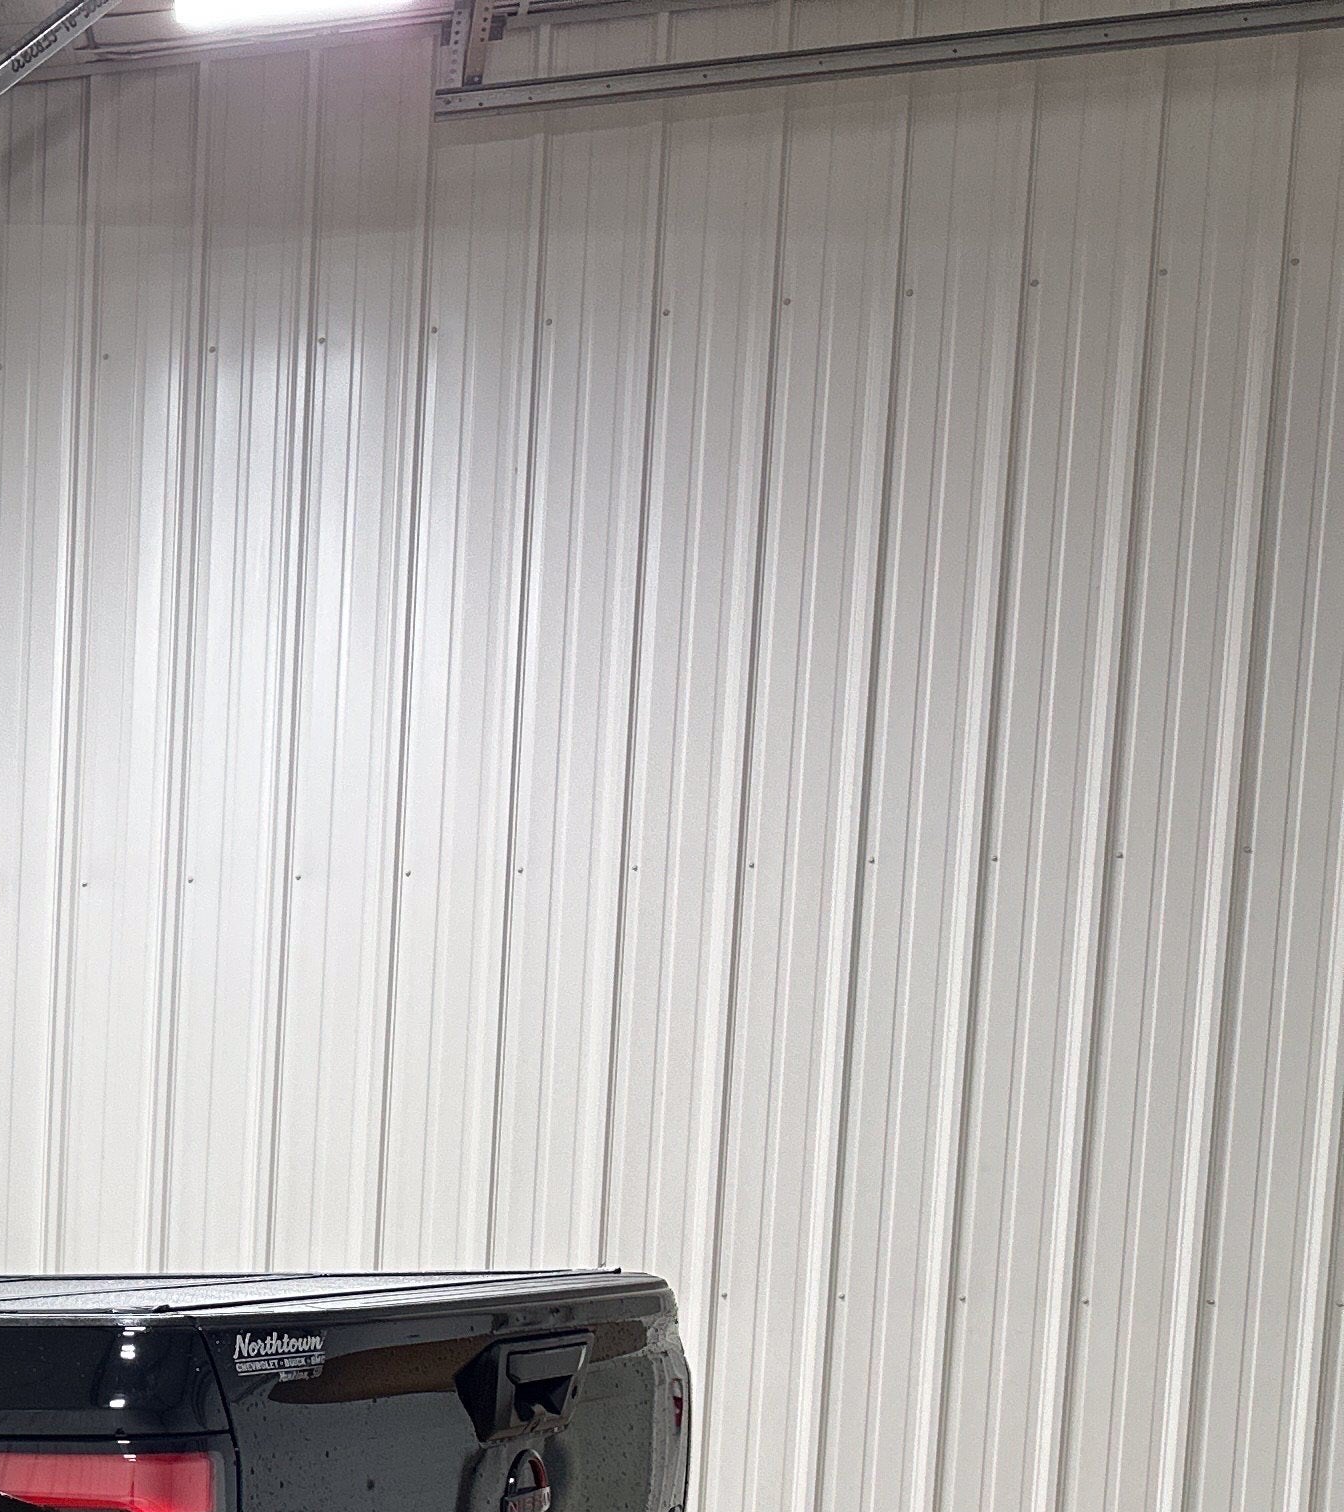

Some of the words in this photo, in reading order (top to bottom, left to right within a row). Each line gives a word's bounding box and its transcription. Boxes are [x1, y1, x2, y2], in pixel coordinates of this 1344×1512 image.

[233, 1331, 324, 1360] Northtown
[236, 1360, 279, 1372] CHEVROLET
[284, 1356, 306, 1368] BUICK
